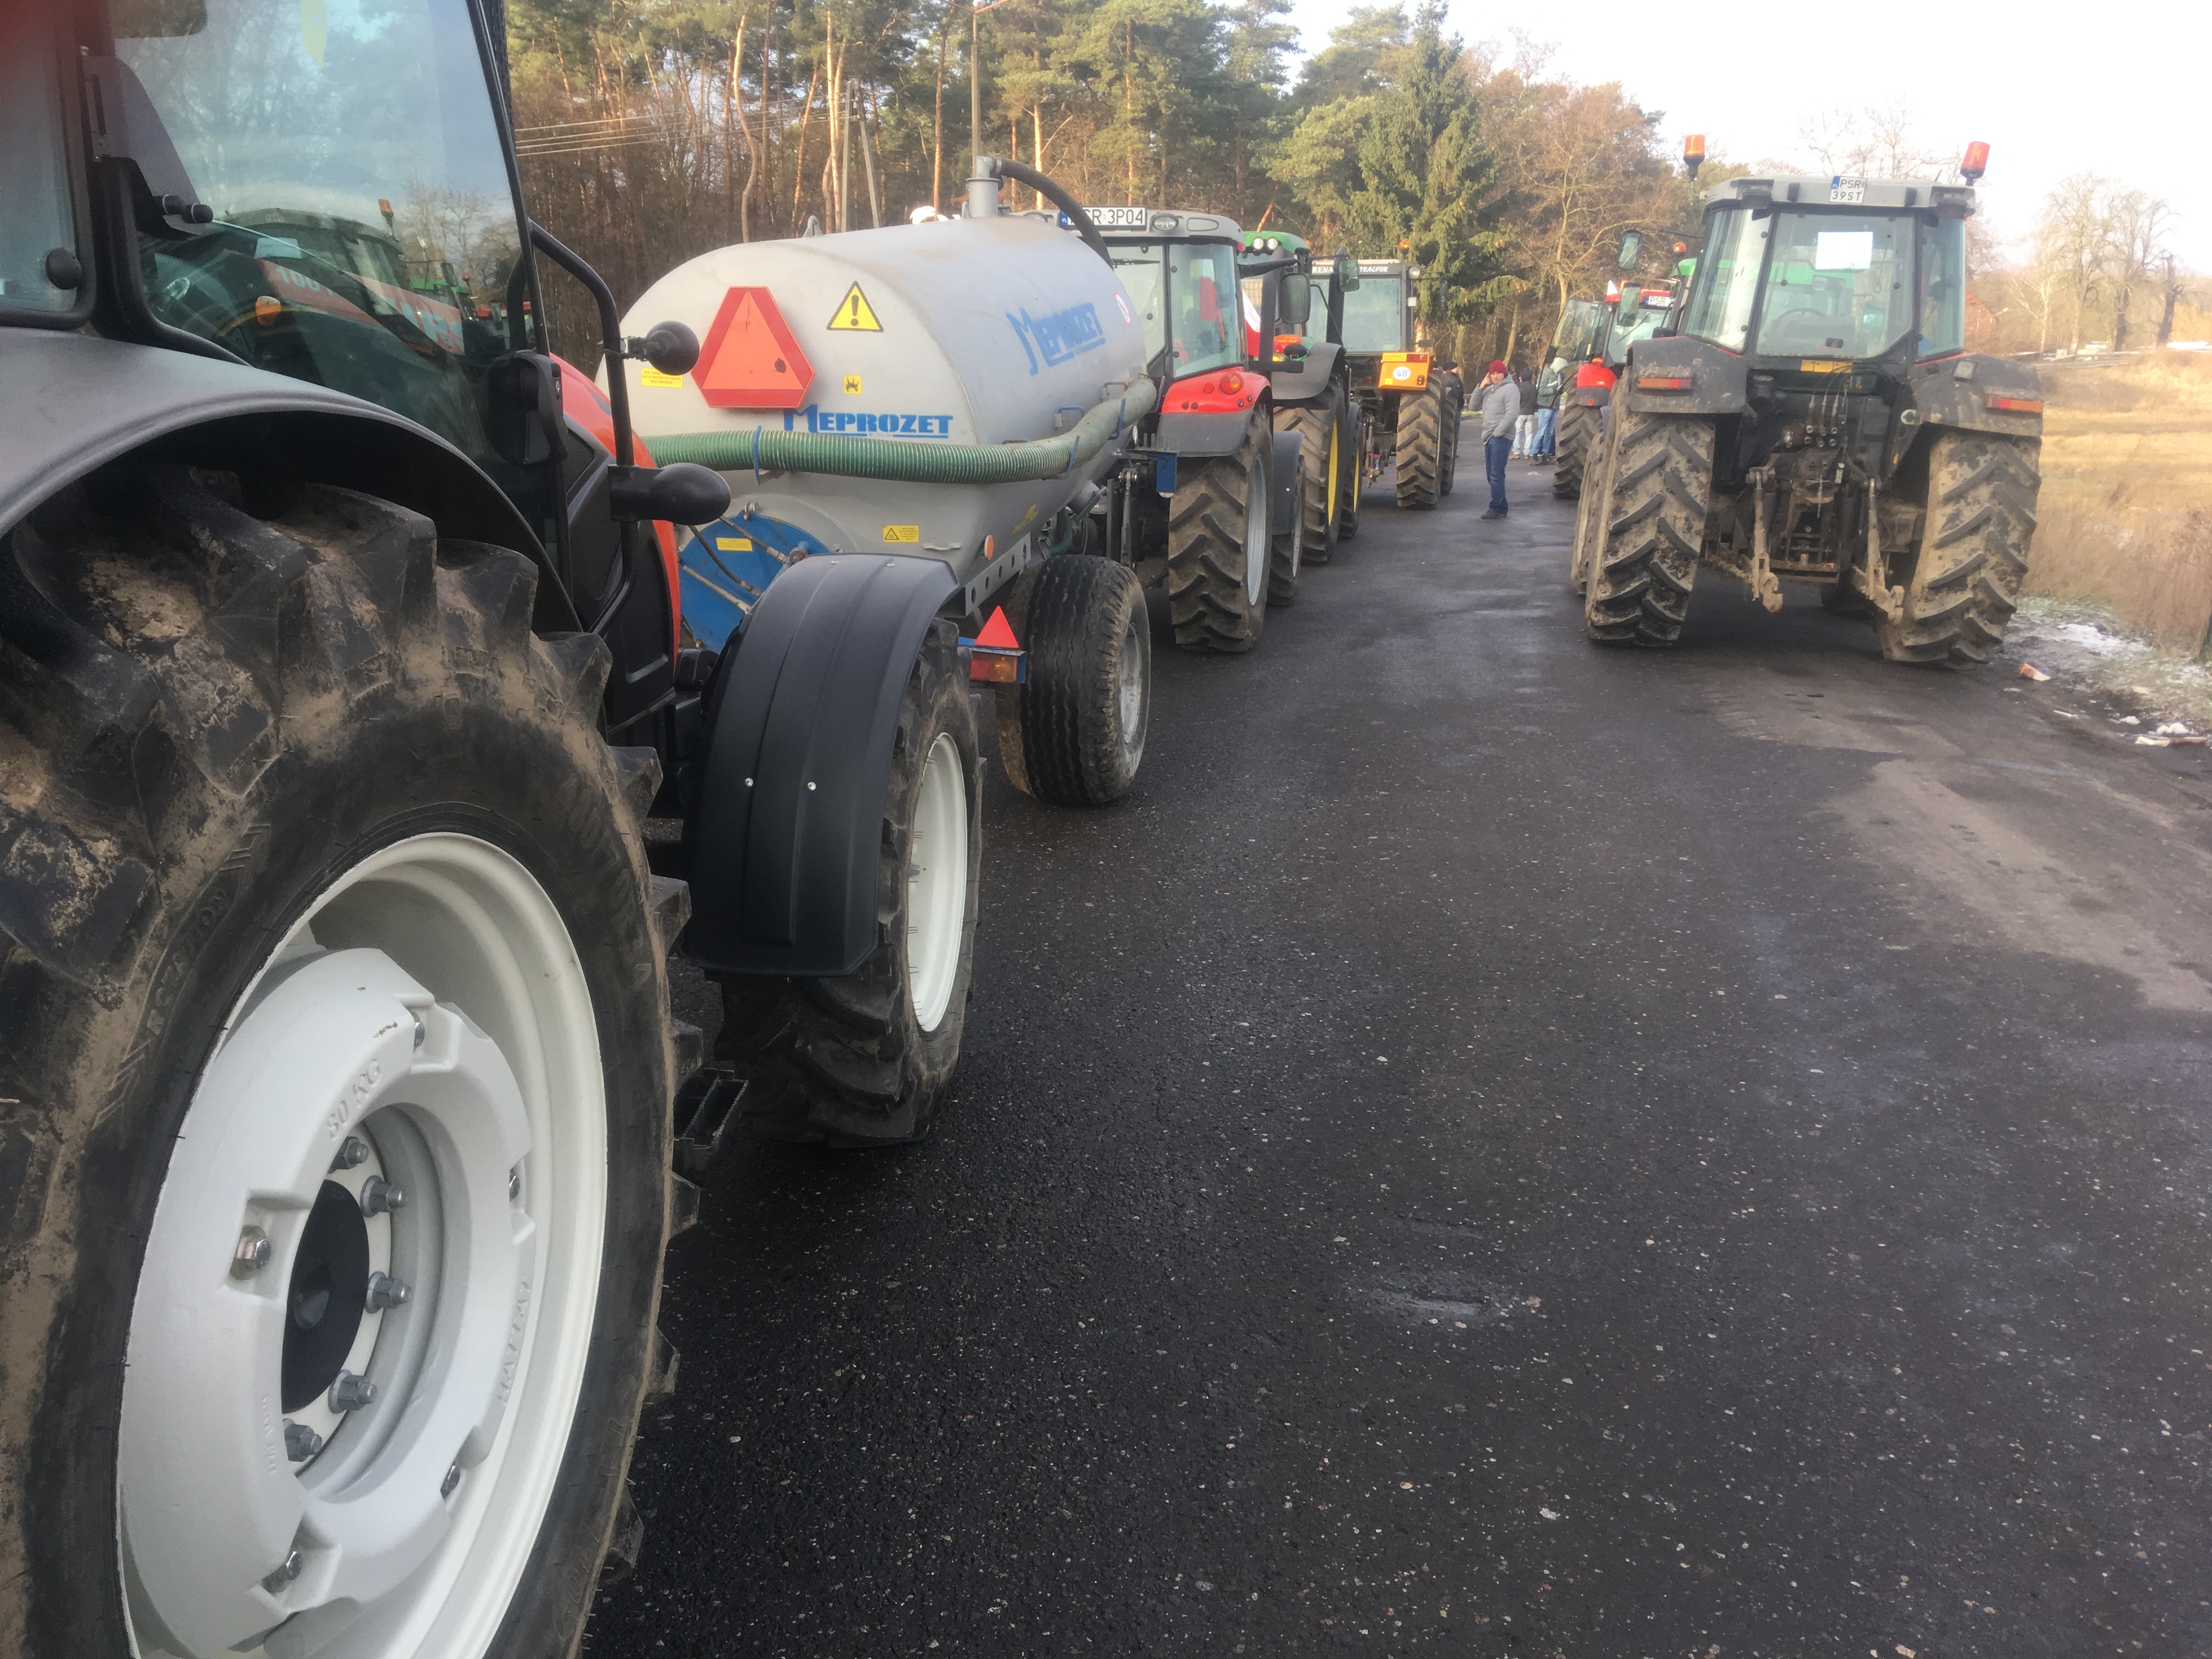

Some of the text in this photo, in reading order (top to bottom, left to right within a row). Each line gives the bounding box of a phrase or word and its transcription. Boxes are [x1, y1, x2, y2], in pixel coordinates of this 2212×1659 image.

[1840, 179, 1861, 189] PSR
[1832, 190, 1862, 201] 39ST
[1108, 209, 1143, 224] 3P04
[276, 266, 332, 296] 100
[1650, 297, 1666, 306] PSR
[783, 404, 953, 435] MEPROZET
[146, 886, 228, 1036] ROTATION
[352, 1058, 382, 1109] KG
